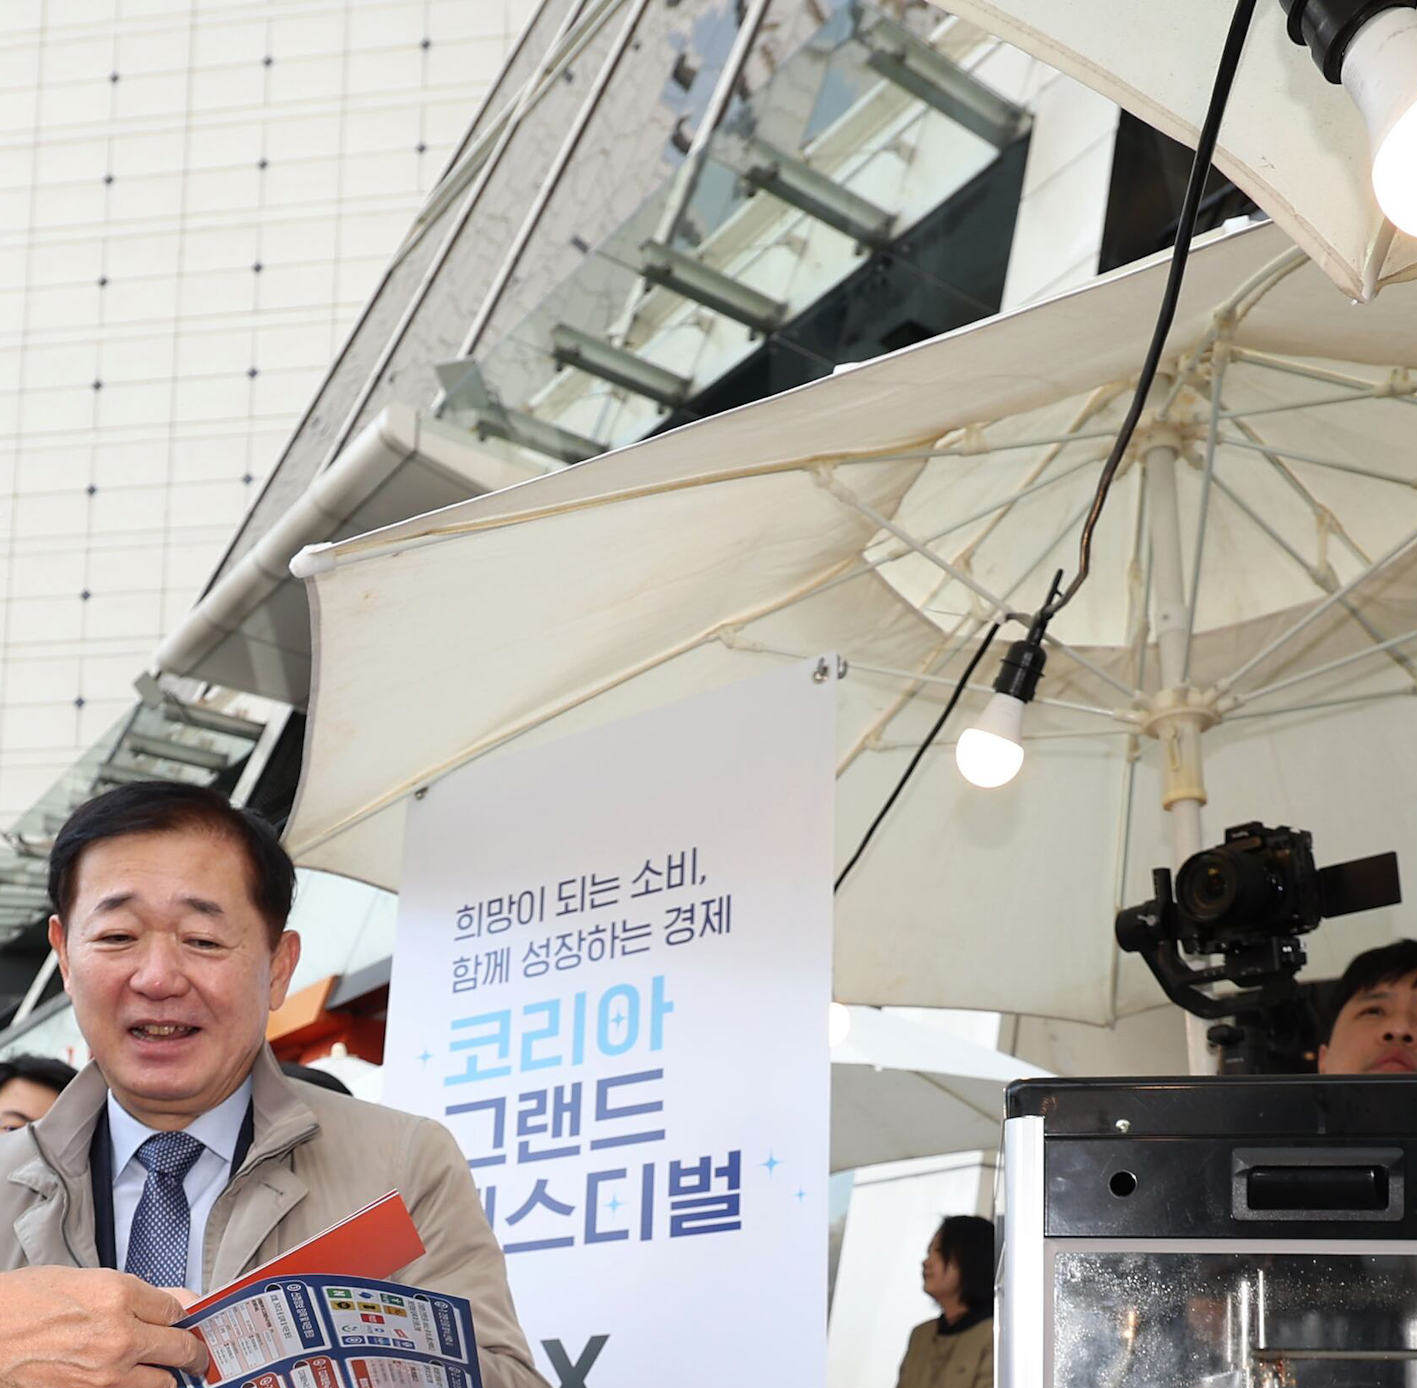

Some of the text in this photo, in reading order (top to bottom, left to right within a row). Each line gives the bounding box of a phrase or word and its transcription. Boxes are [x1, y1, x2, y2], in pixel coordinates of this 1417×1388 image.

[450, 893, 734, 996] 함께 성장하는 경제
[452, 846, 708, 944] 희망이 되는 소비,
[444, 974, 675, 1088] 코리아
[444, 1067, 667, 1169] 그랜드
